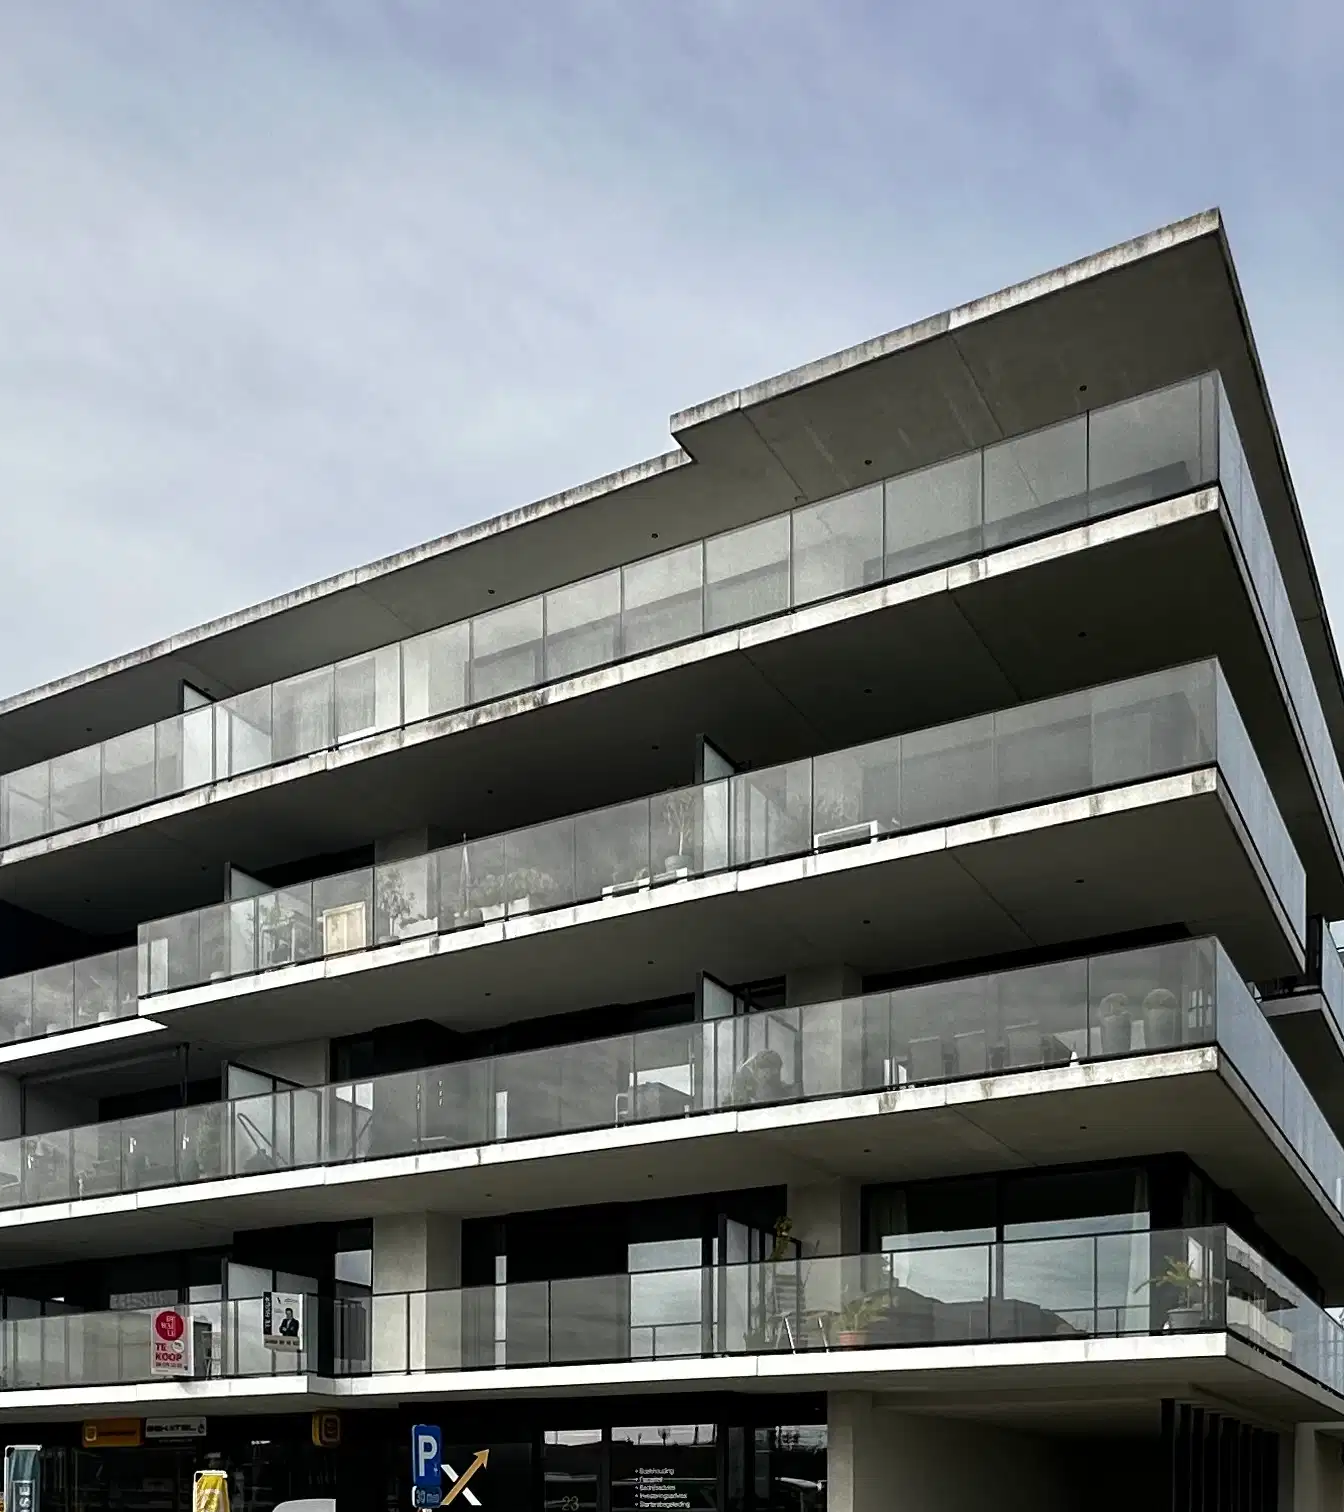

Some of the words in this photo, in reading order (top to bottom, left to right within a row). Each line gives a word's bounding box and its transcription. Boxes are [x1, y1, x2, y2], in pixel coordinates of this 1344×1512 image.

[155, 1343, 167, 1352] TE
[155, 1352, 182, 1362] KOOP
[417, 1435, 438, 1477] P
[561, 1495, 580, 1511] 23
